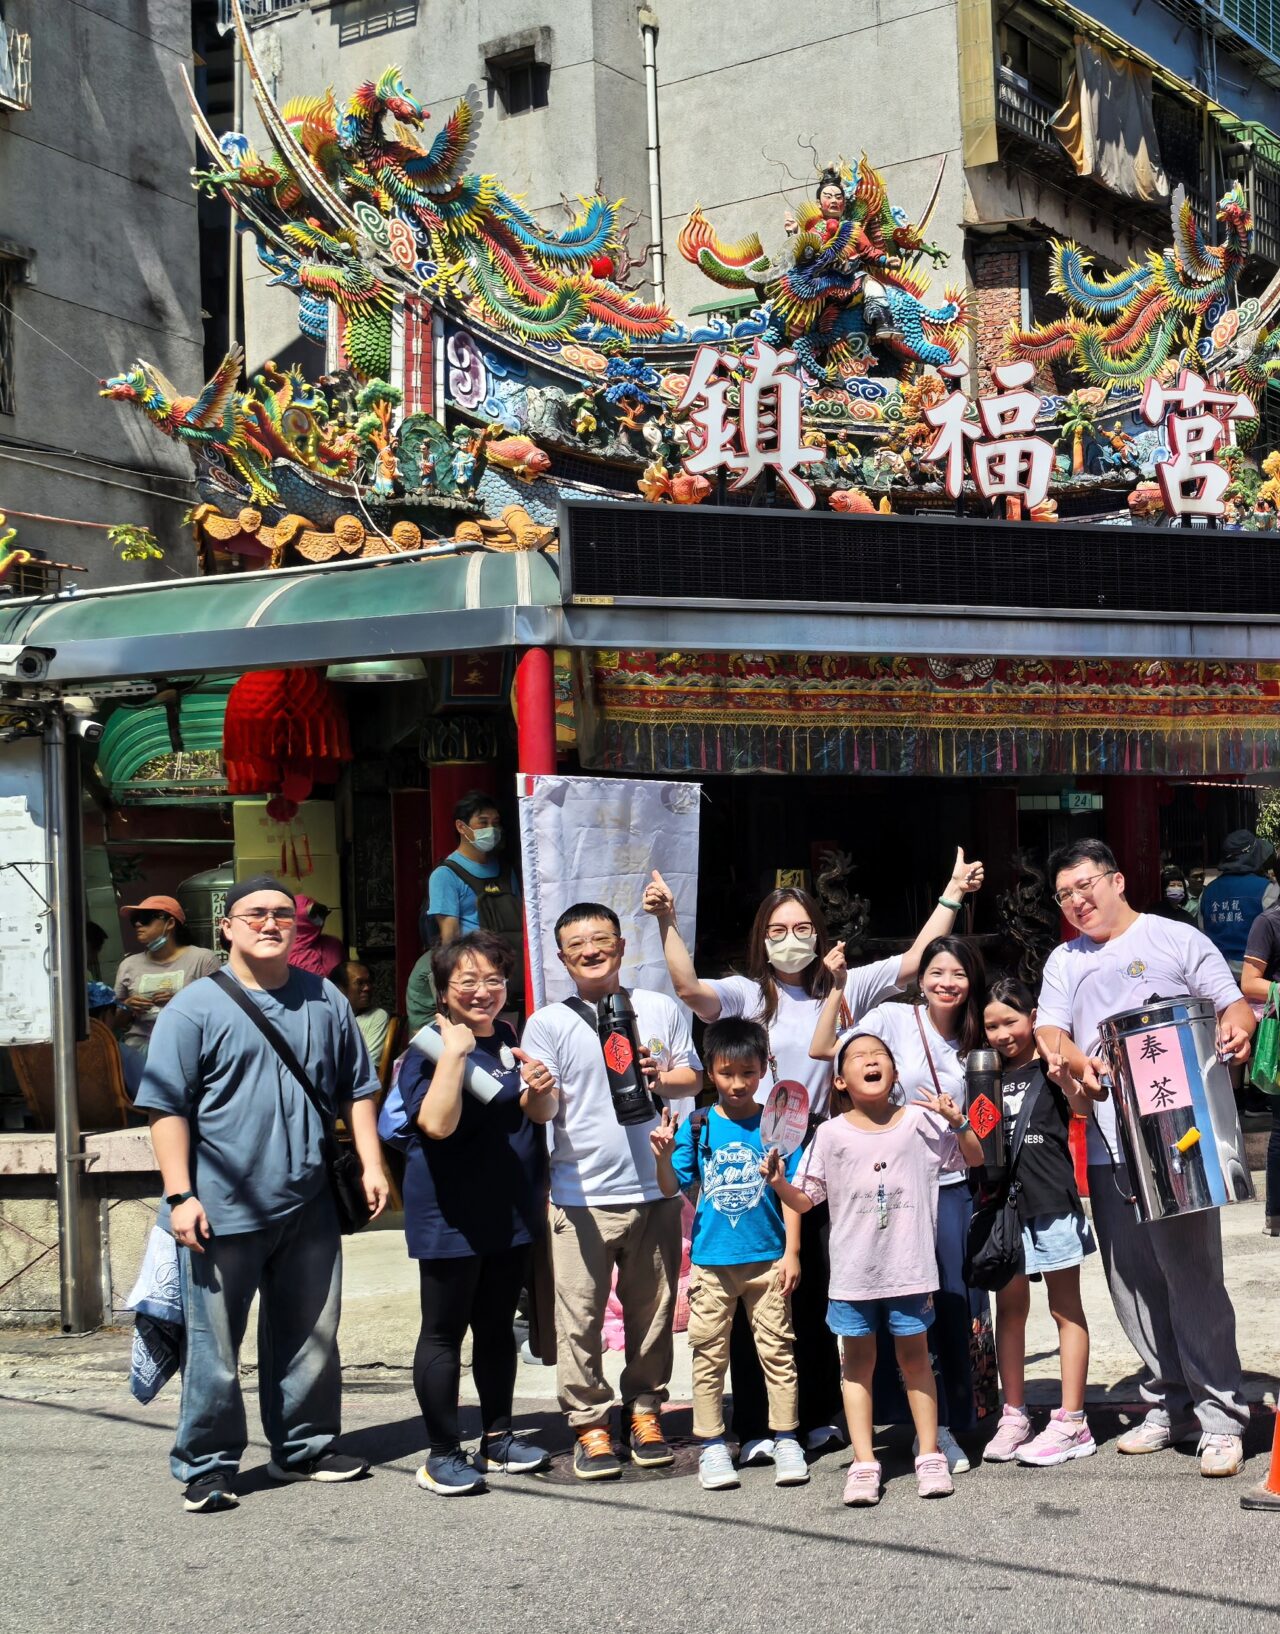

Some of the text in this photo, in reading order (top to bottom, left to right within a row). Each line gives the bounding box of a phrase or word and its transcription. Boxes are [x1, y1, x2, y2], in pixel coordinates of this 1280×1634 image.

[681, 339, 1256, 516] 鎮福宮
[1074, 795, 1087, 807] 24
[1140, 1034, 1178, 1108] 奉茶
